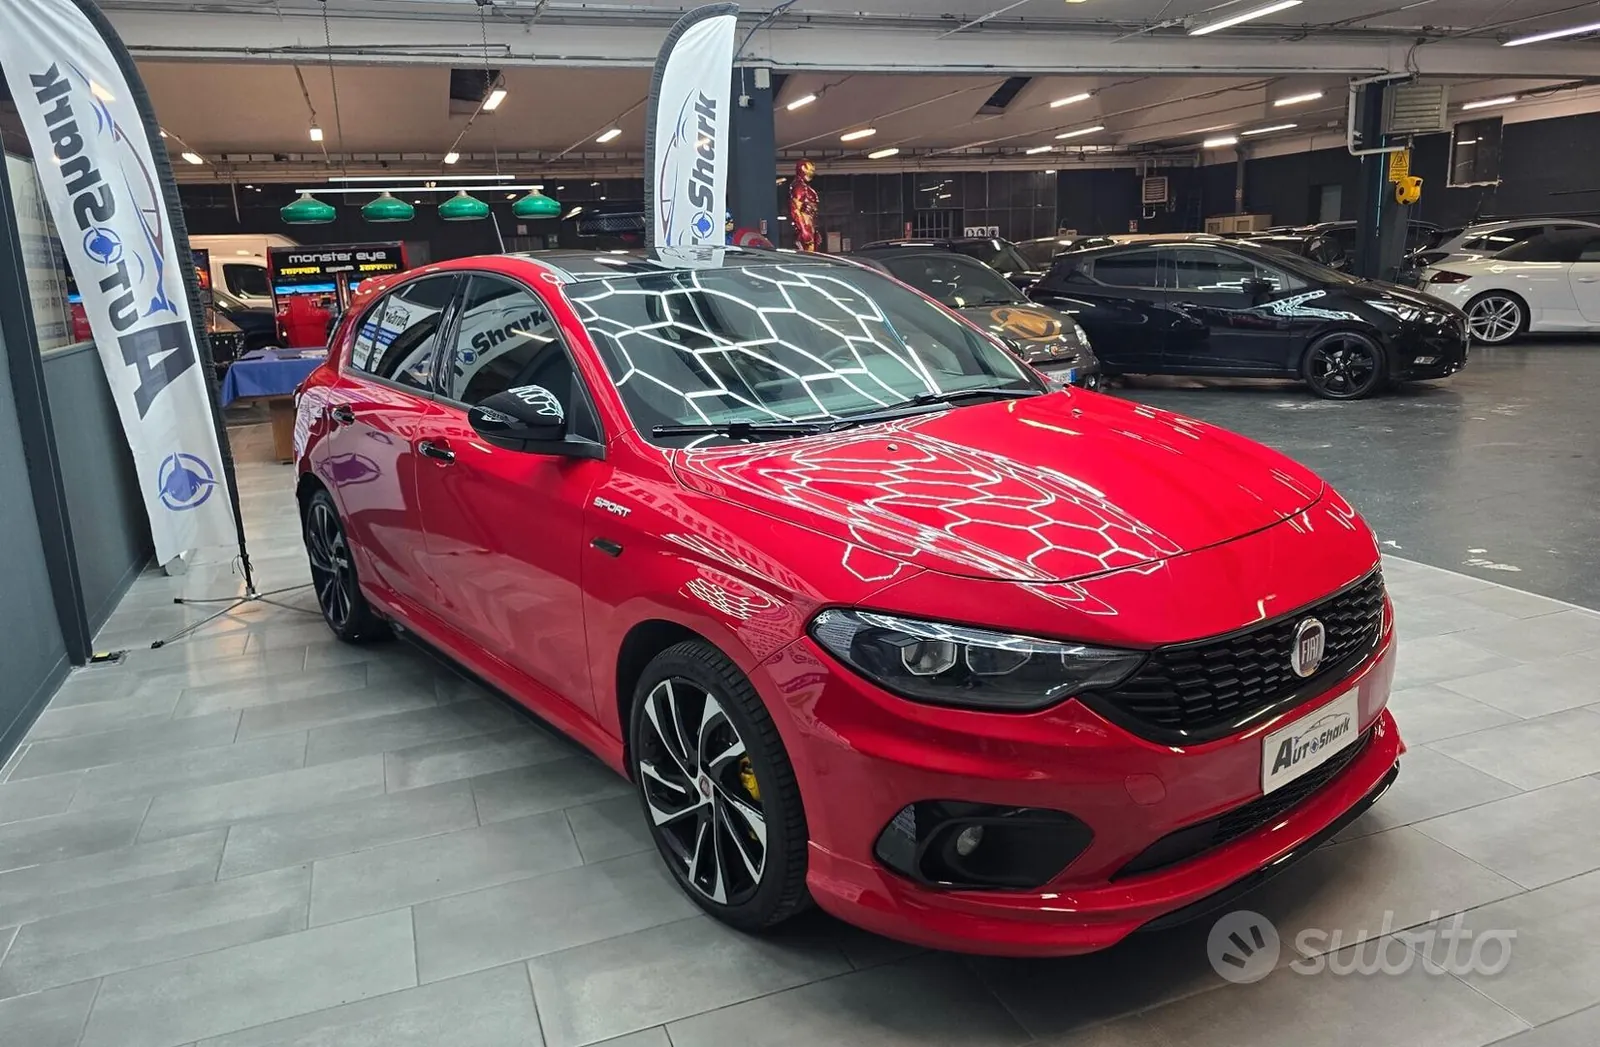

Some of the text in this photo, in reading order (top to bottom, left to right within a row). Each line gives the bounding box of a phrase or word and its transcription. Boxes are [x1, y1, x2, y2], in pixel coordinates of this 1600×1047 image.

[288, 251, 386, 263] monster eye
[593, 496, 632, 517] SPORT
[1301, 634, 1320, 665] FIAT
